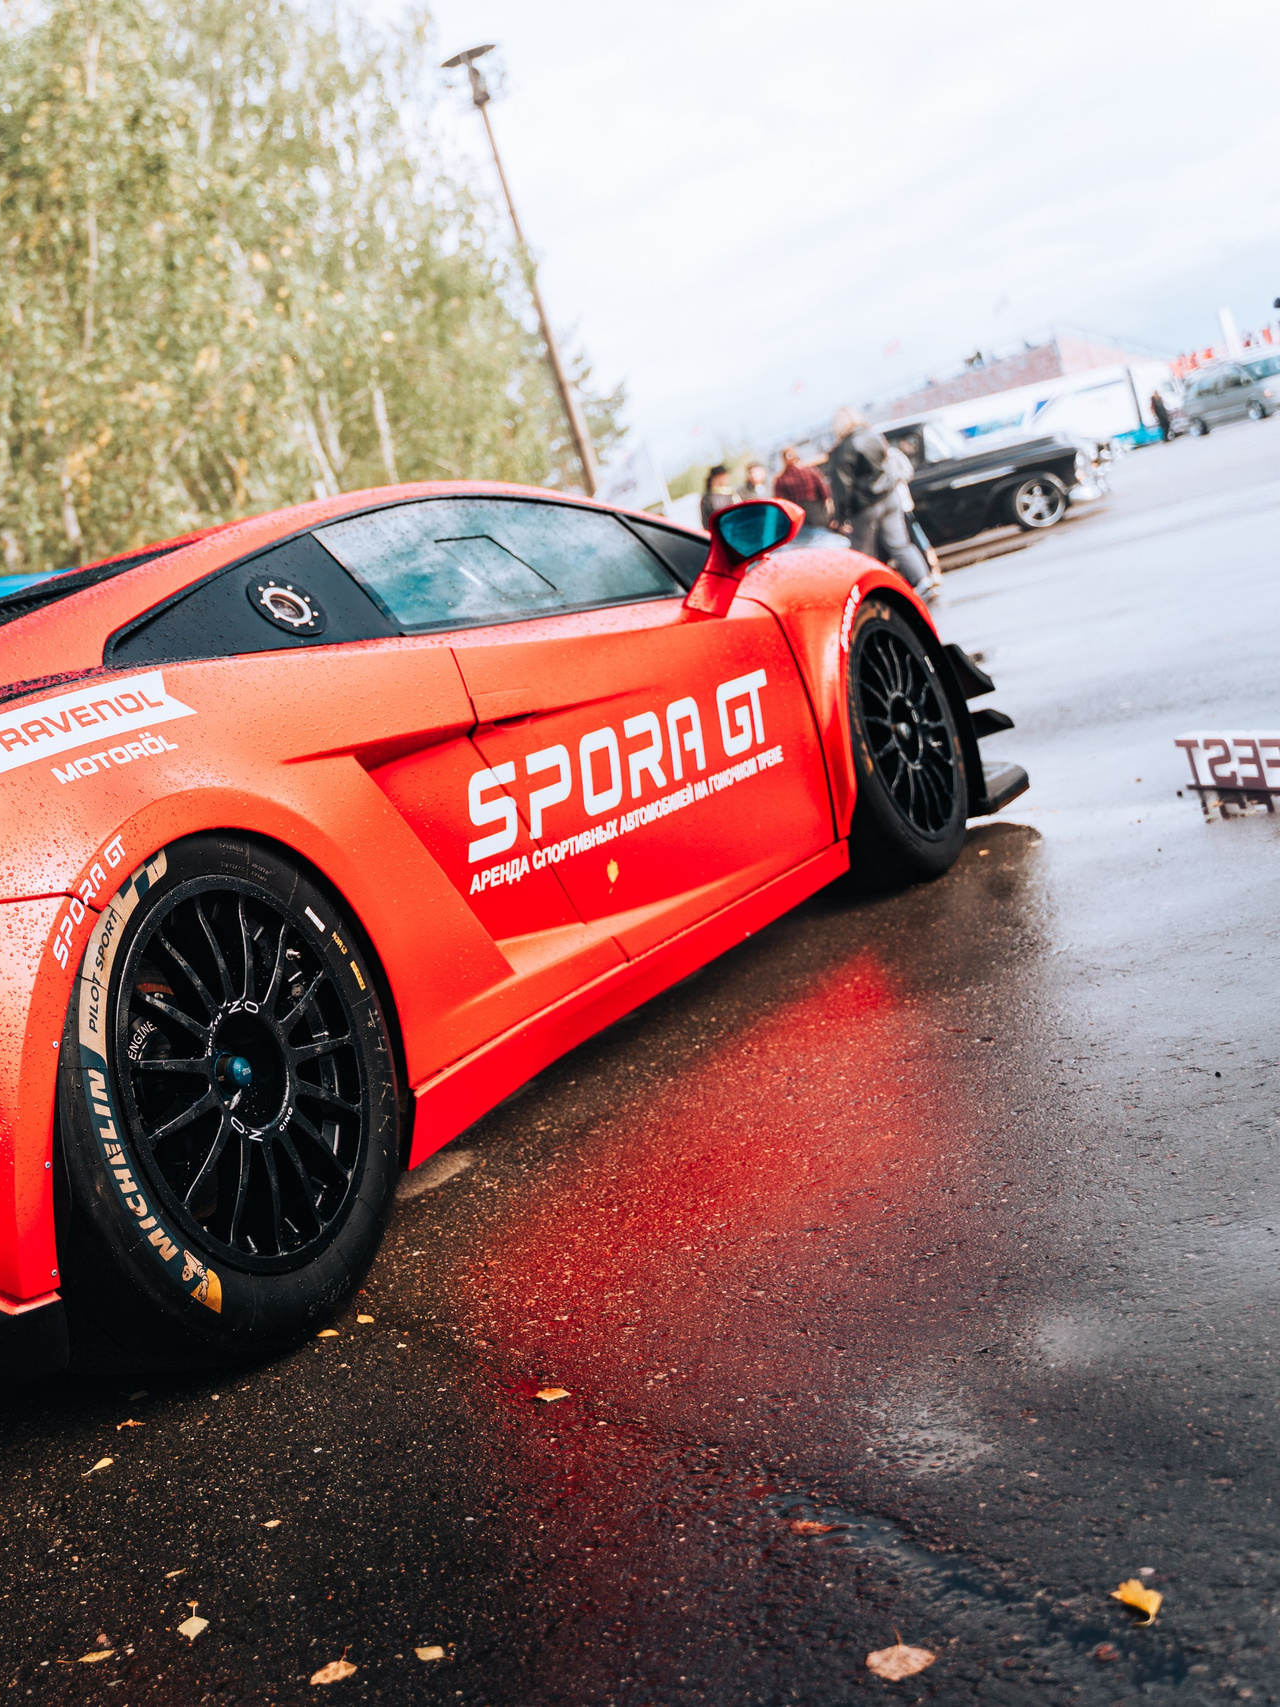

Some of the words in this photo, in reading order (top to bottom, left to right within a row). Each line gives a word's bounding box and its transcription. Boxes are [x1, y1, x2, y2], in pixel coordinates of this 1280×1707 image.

[50, 732, 179, 785] MOTORÖL
[468, 696, 707, 863] SPORA
[716, 668, 768, 758] GT
[53, 863, 107, 970] SPORA
[103, 834, 126, 869] GT
[469, 855, 531, 895] АРЕНДА
[532, 818, 619, 870] СПОРТИВНЫХ
[619, 782, 695, 835] АВТОМОБИЛЕЙ
[693, 780, 709, 801] НА
[88, 972, 101, 1034] PILOT
[95, 908, 118, 971] SPORT
[87, 1068, 180, 1262] MICHELIN
